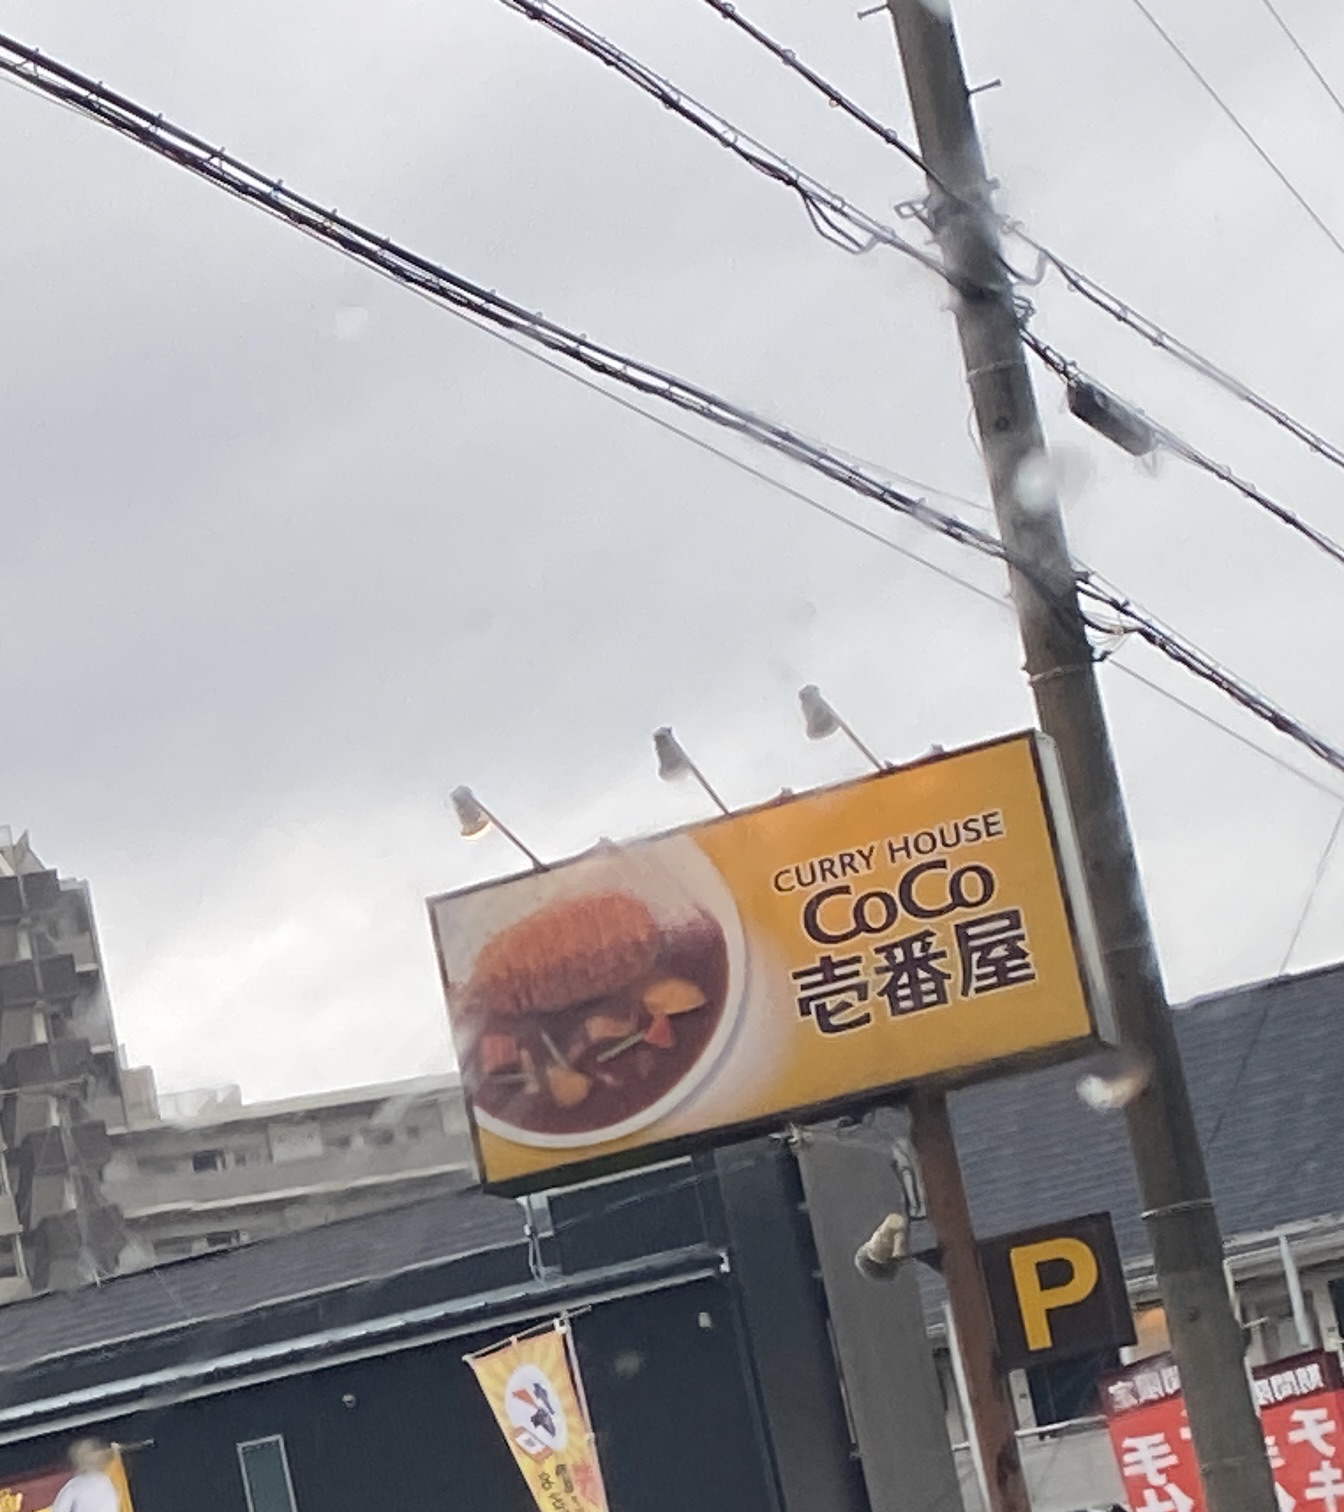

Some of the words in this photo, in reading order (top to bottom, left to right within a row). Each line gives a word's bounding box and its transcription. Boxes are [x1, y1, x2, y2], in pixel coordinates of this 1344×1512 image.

[772, 843, 875, 894] CURRY
[887, 810, 1005, 862] HOUSE
[802, 858, 996, 945] CoCo
[791, 909, 1037, 1036] 壱番屋
[1010, 1237, 1098, 1350] P
